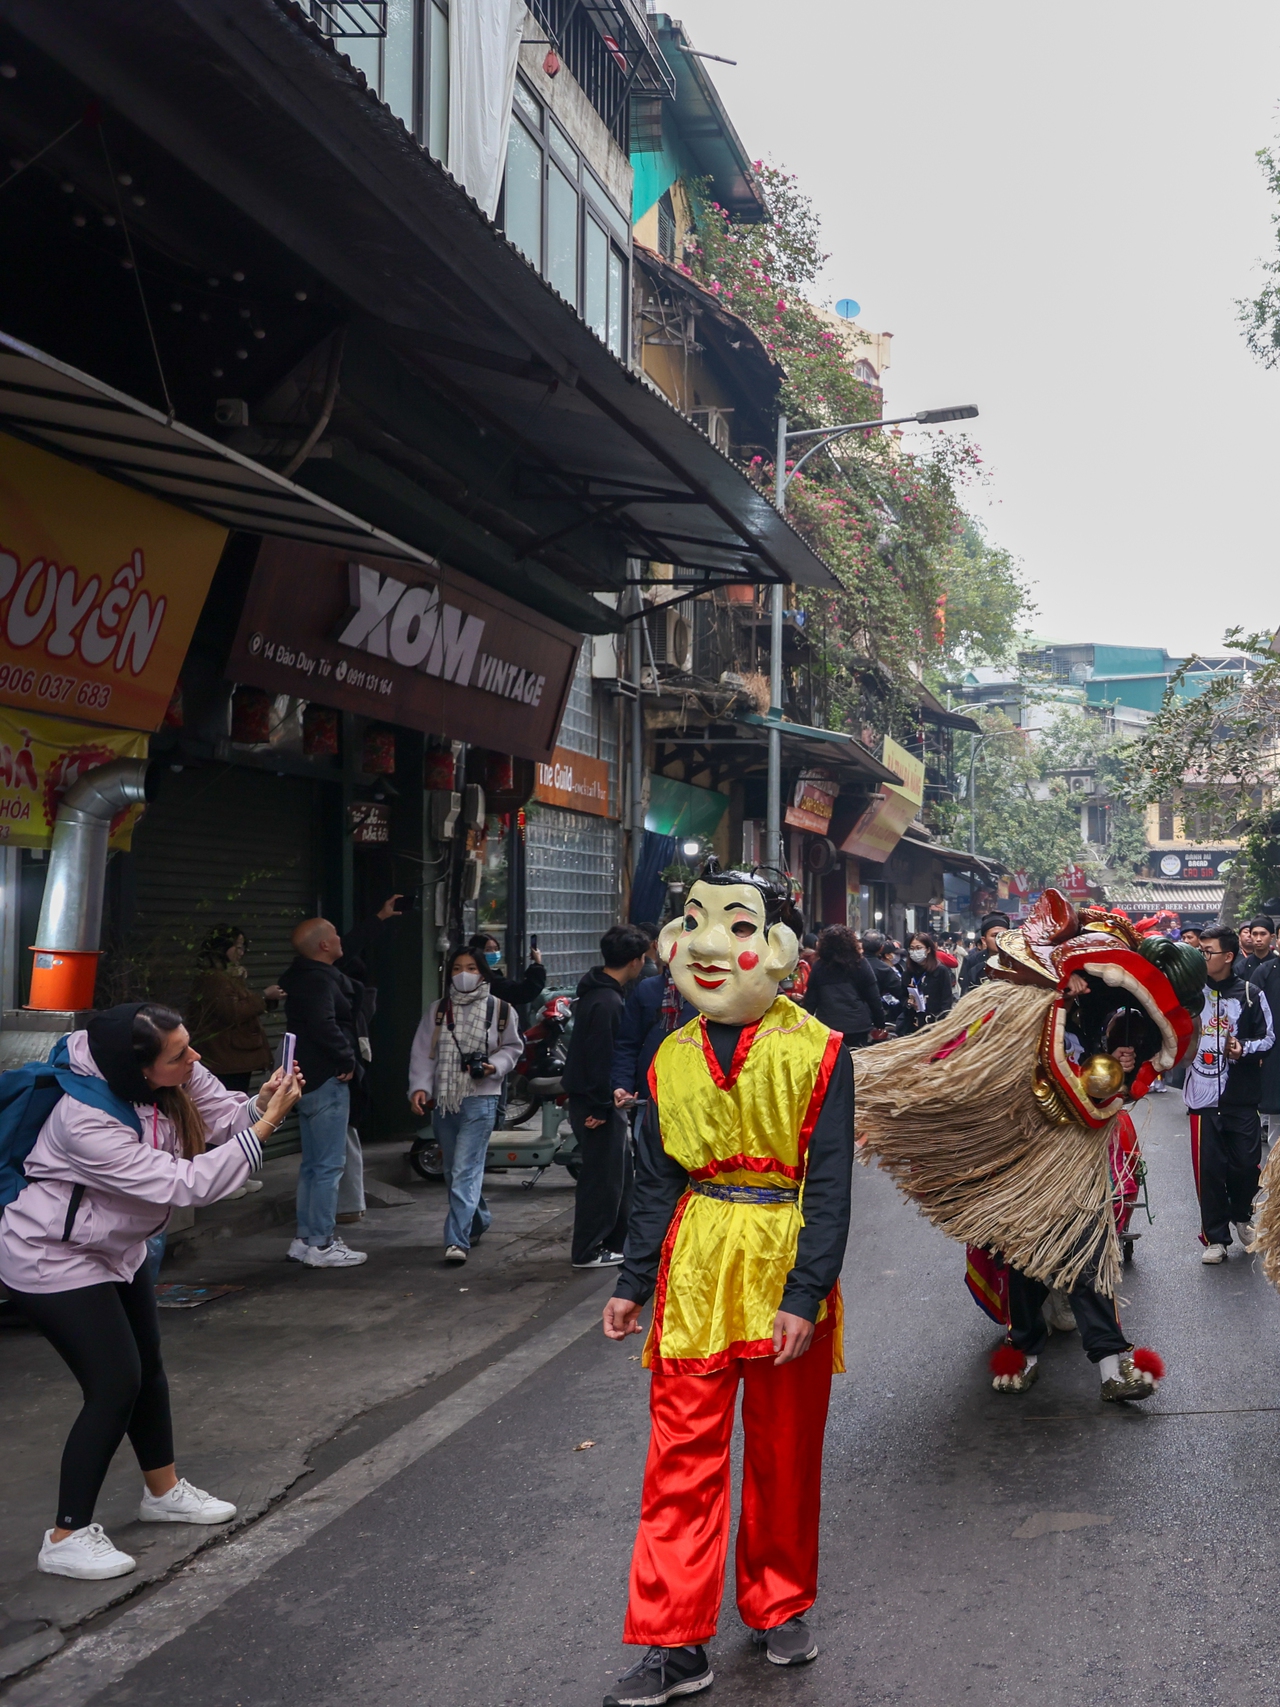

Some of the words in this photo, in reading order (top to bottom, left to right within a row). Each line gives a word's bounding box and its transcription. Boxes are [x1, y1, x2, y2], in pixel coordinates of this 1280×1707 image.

[338, 564, 486, 687] XÓM
[263, 641, 276, 660] 14
[296, 652, 316, 676] Duy
[38, 674, 75, 702] 037
[77, 682, 111, 709] 683
[347, 668, 366, 687] 0911
[366, 673, 379, 691] 131
[379, 678, 393, 696] 164
[477, 653, 546, 707] VINTAGE
[538, 762, 553, 787] The
[554, 763, 573, 792] Guild
[1183, 868, 1198, 878] CAO
[1201, 868, 1214, 878] GIA
